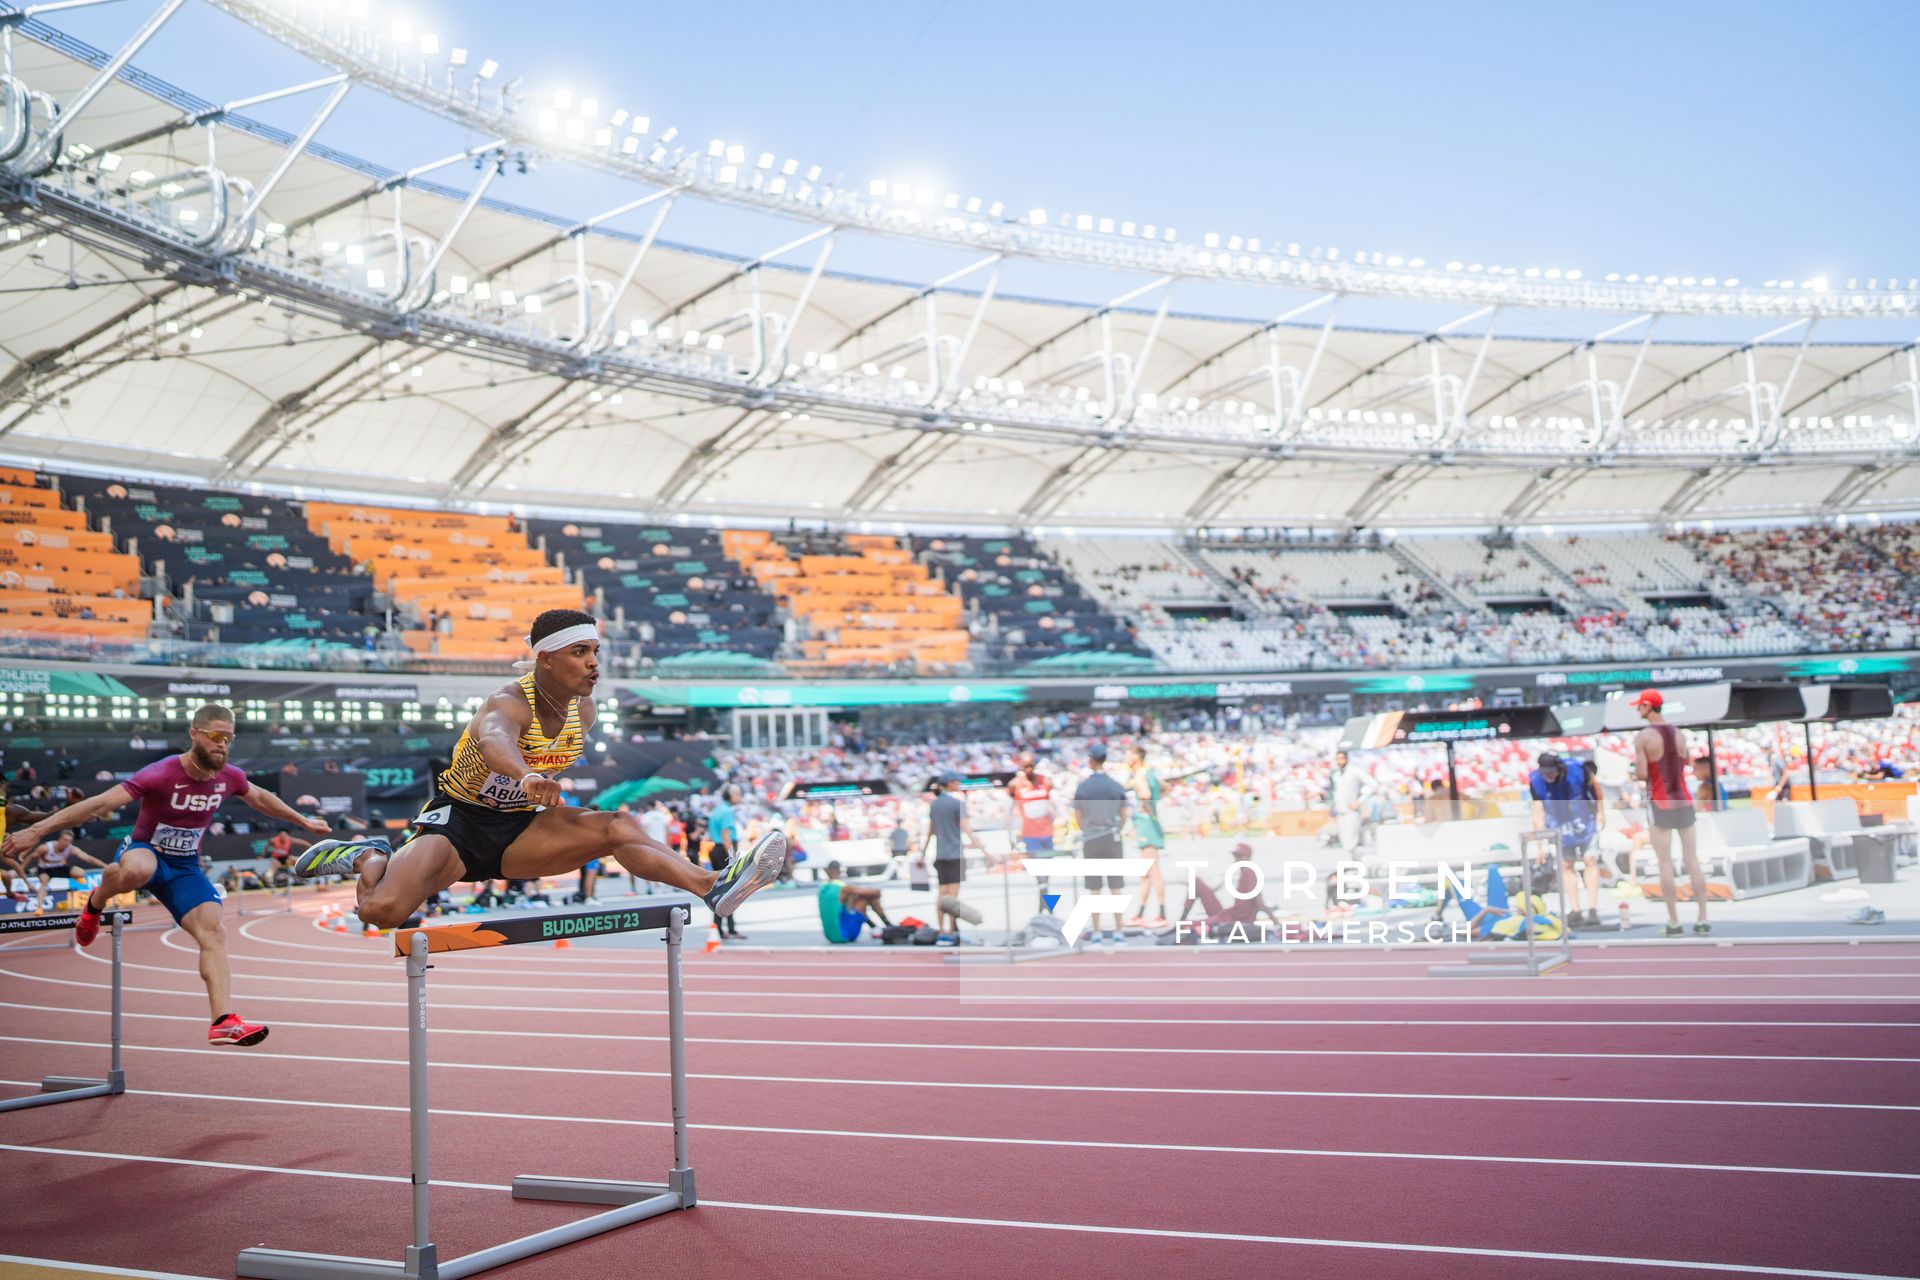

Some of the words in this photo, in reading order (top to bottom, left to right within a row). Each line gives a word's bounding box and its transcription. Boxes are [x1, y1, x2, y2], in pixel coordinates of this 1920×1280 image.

[170, 792, 222, 811] USA
[159, 838, 193, 850] ALLEN
[8, 918, 47, 928] ATHLETICS
[543, 915, 621, 937] BUDAPEST
[623, 912, 640, 928] 23
